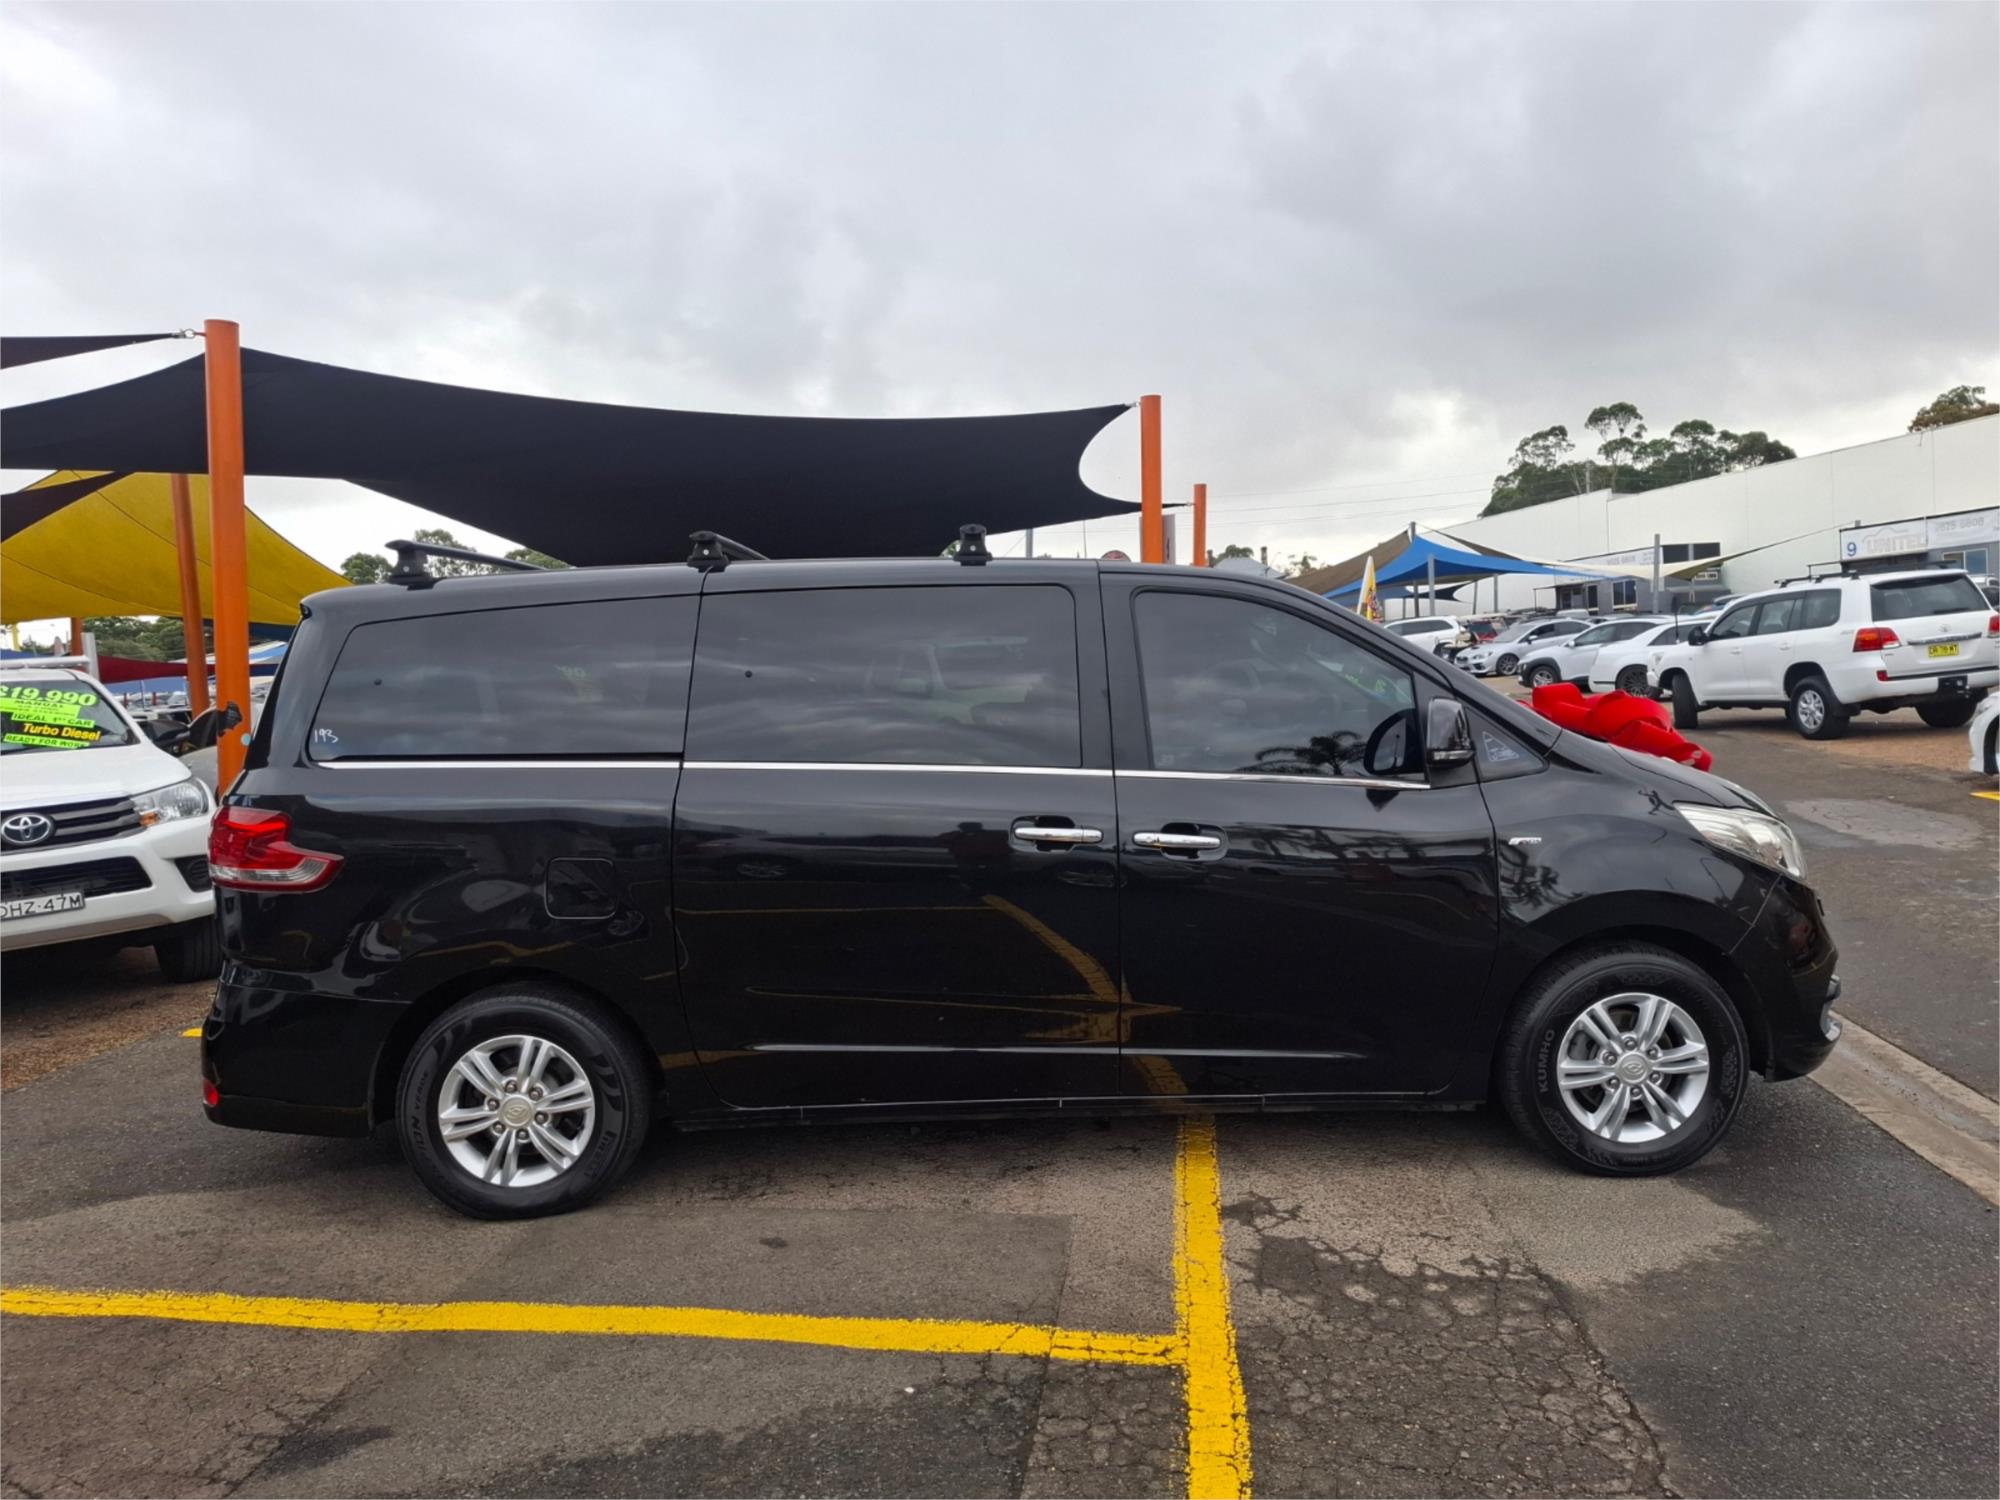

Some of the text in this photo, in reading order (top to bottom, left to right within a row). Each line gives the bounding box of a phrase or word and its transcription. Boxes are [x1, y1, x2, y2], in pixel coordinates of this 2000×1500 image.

[1846, 541, 1857, 557] 9
[14, 713, 47, 721] IDEAL
[6, 734, 38, 743] READY
[23, 723, 101, 741] Turbo Diesel
[314, 728, 338, 743] 193
[1539, 1029, 1556, 1093] KUMHO
